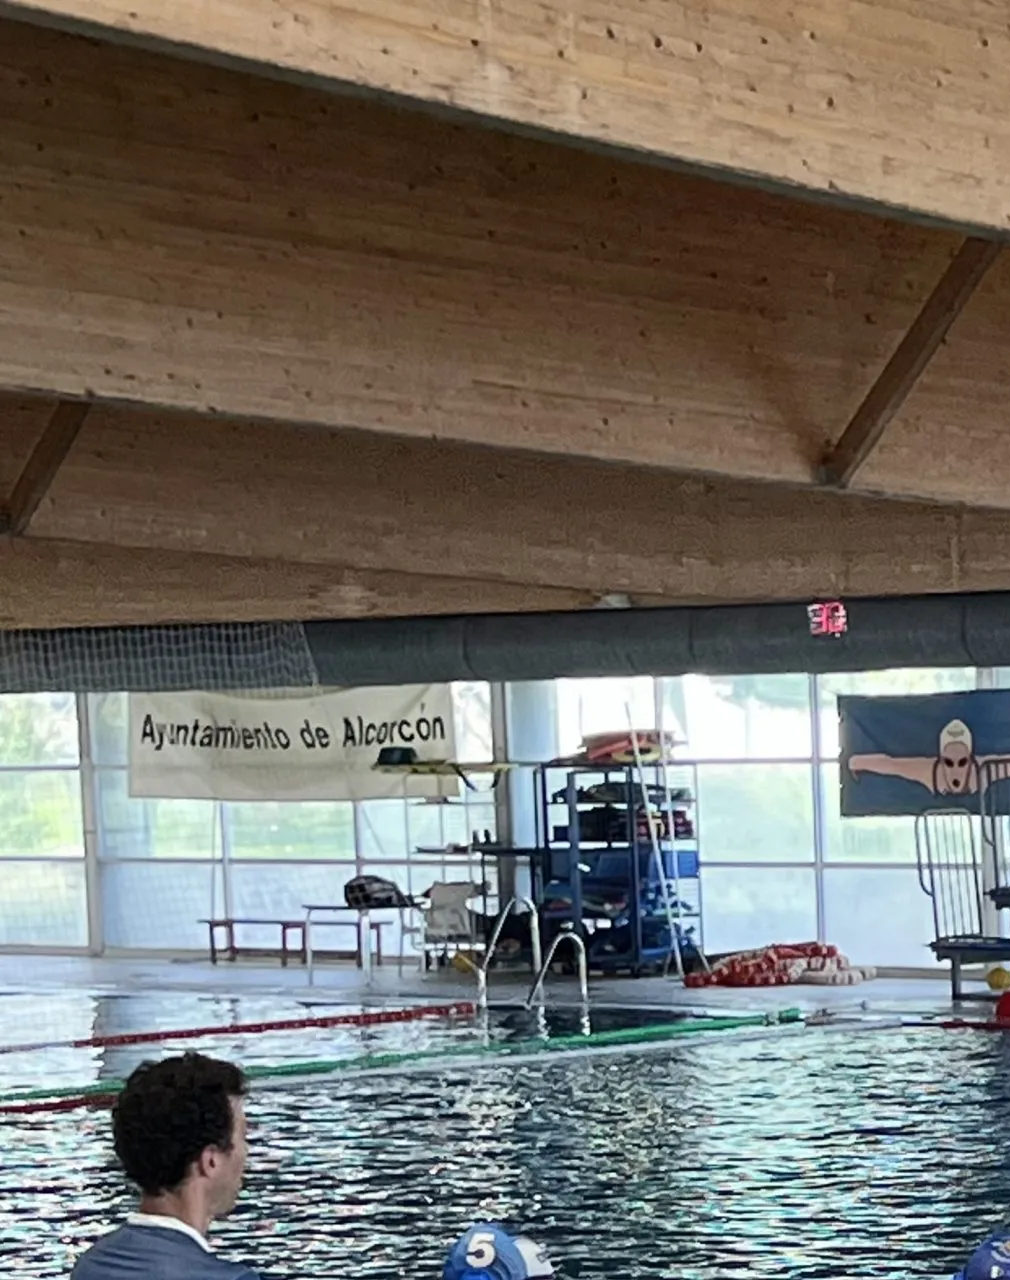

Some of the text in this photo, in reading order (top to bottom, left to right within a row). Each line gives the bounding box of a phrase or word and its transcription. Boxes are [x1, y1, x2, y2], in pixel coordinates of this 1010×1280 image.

[141, 703, 445, 750] Ayuntamiento de Alcorcón
[466, 1232, 496, 1269] 5
